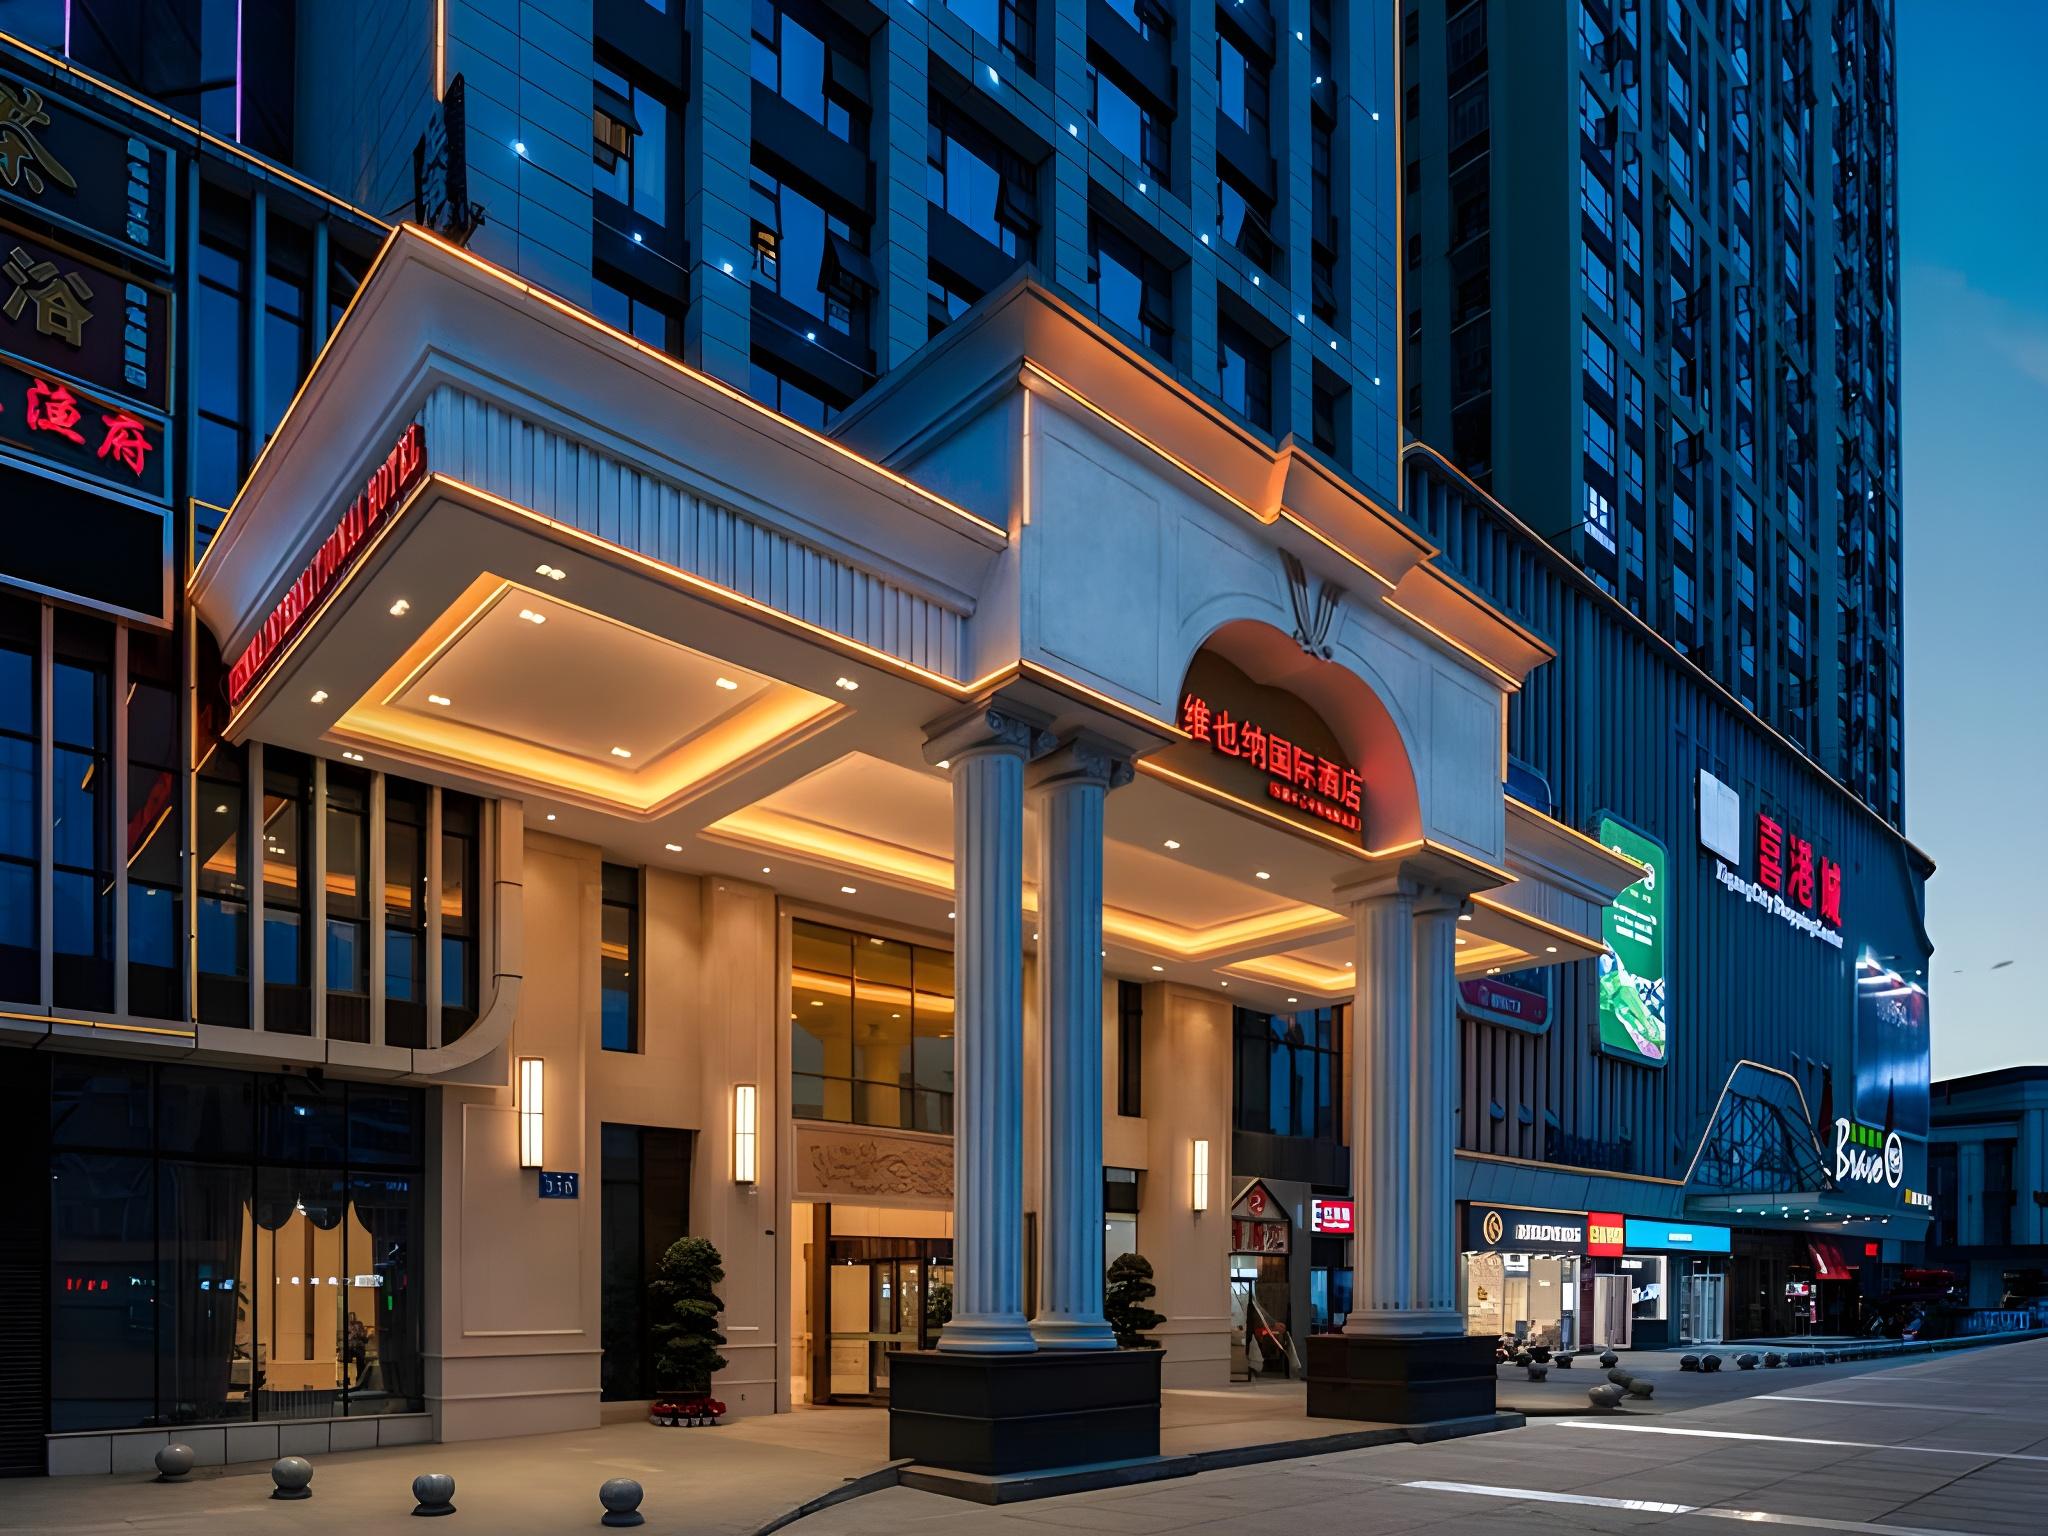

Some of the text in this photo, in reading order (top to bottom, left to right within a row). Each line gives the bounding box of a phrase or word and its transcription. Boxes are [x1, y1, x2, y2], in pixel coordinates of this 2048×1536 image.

[0, 377, 153, 477] 渔府
[1183, 692, 1364, 812] 维也纳国际酒店
